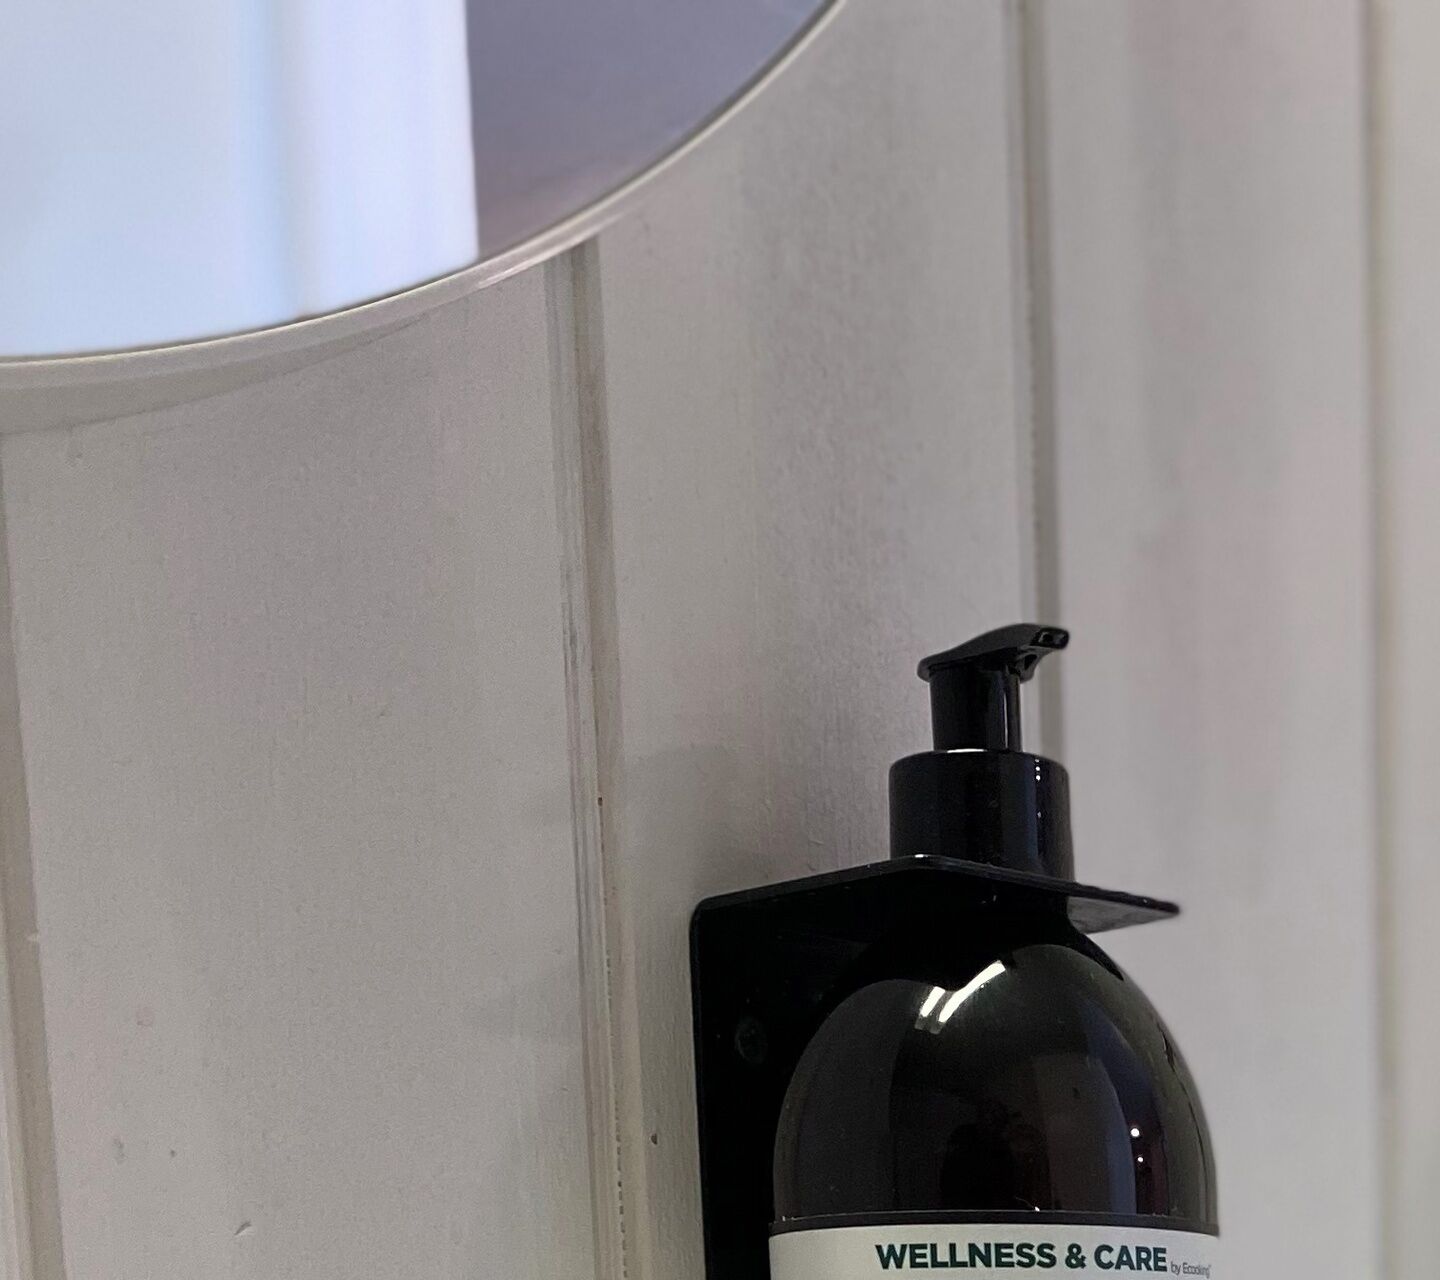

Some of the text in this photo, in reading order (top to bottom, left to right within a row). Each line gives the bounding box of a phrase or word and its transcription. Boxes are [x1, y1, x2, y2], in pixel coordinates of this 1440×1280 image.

[875, 1243, 1057, 1270] WELLNESS
[1065, 1244, 1086, 1268] &
[1094, 1245, 1168, 1273] CARE
